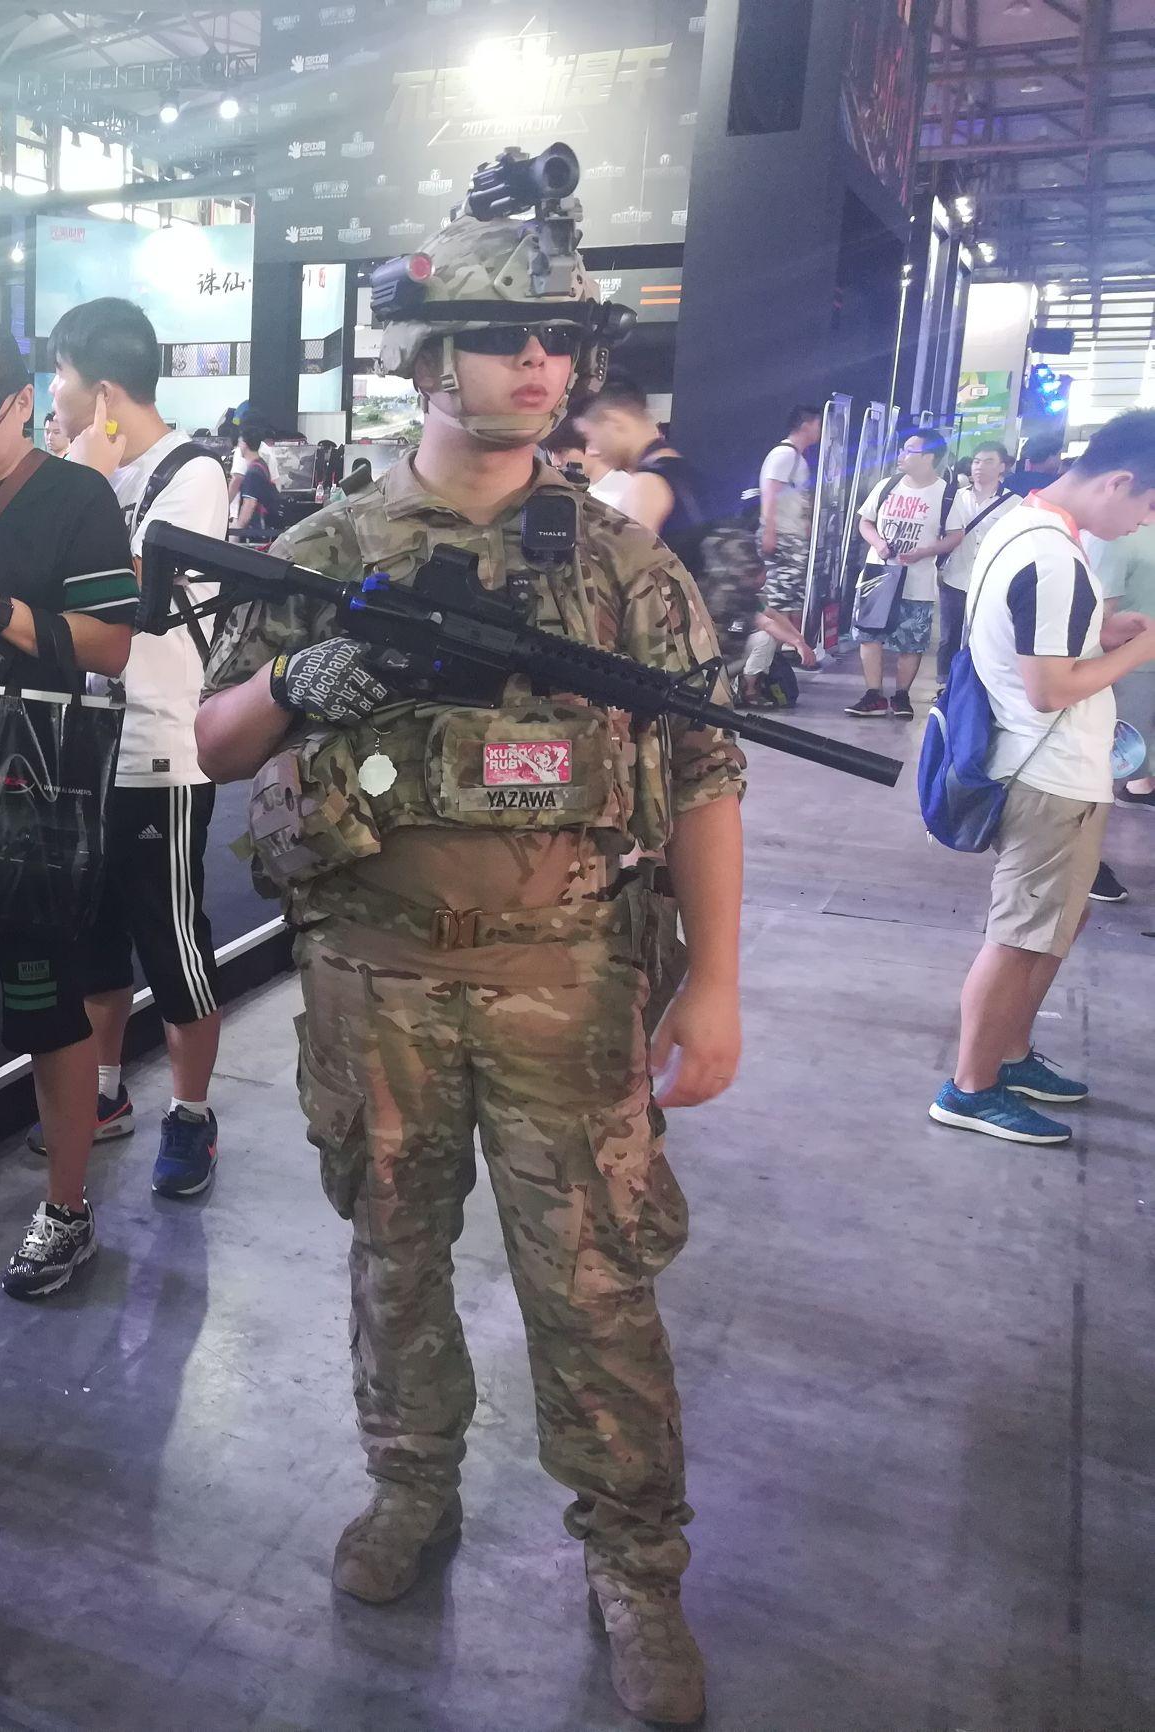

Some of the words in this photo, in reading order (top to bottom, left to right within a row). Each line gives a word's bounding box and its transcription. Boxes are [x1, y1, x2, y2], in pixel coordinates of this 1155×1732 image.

[461, 120, 491, 137] 2017
[299, 226, 323, 236] 空中网
[289, 649, 333, 705] Mechanix
[307, 643, 362, 707] Mechanix
[487, 790, 556, 808] YAZAWA
